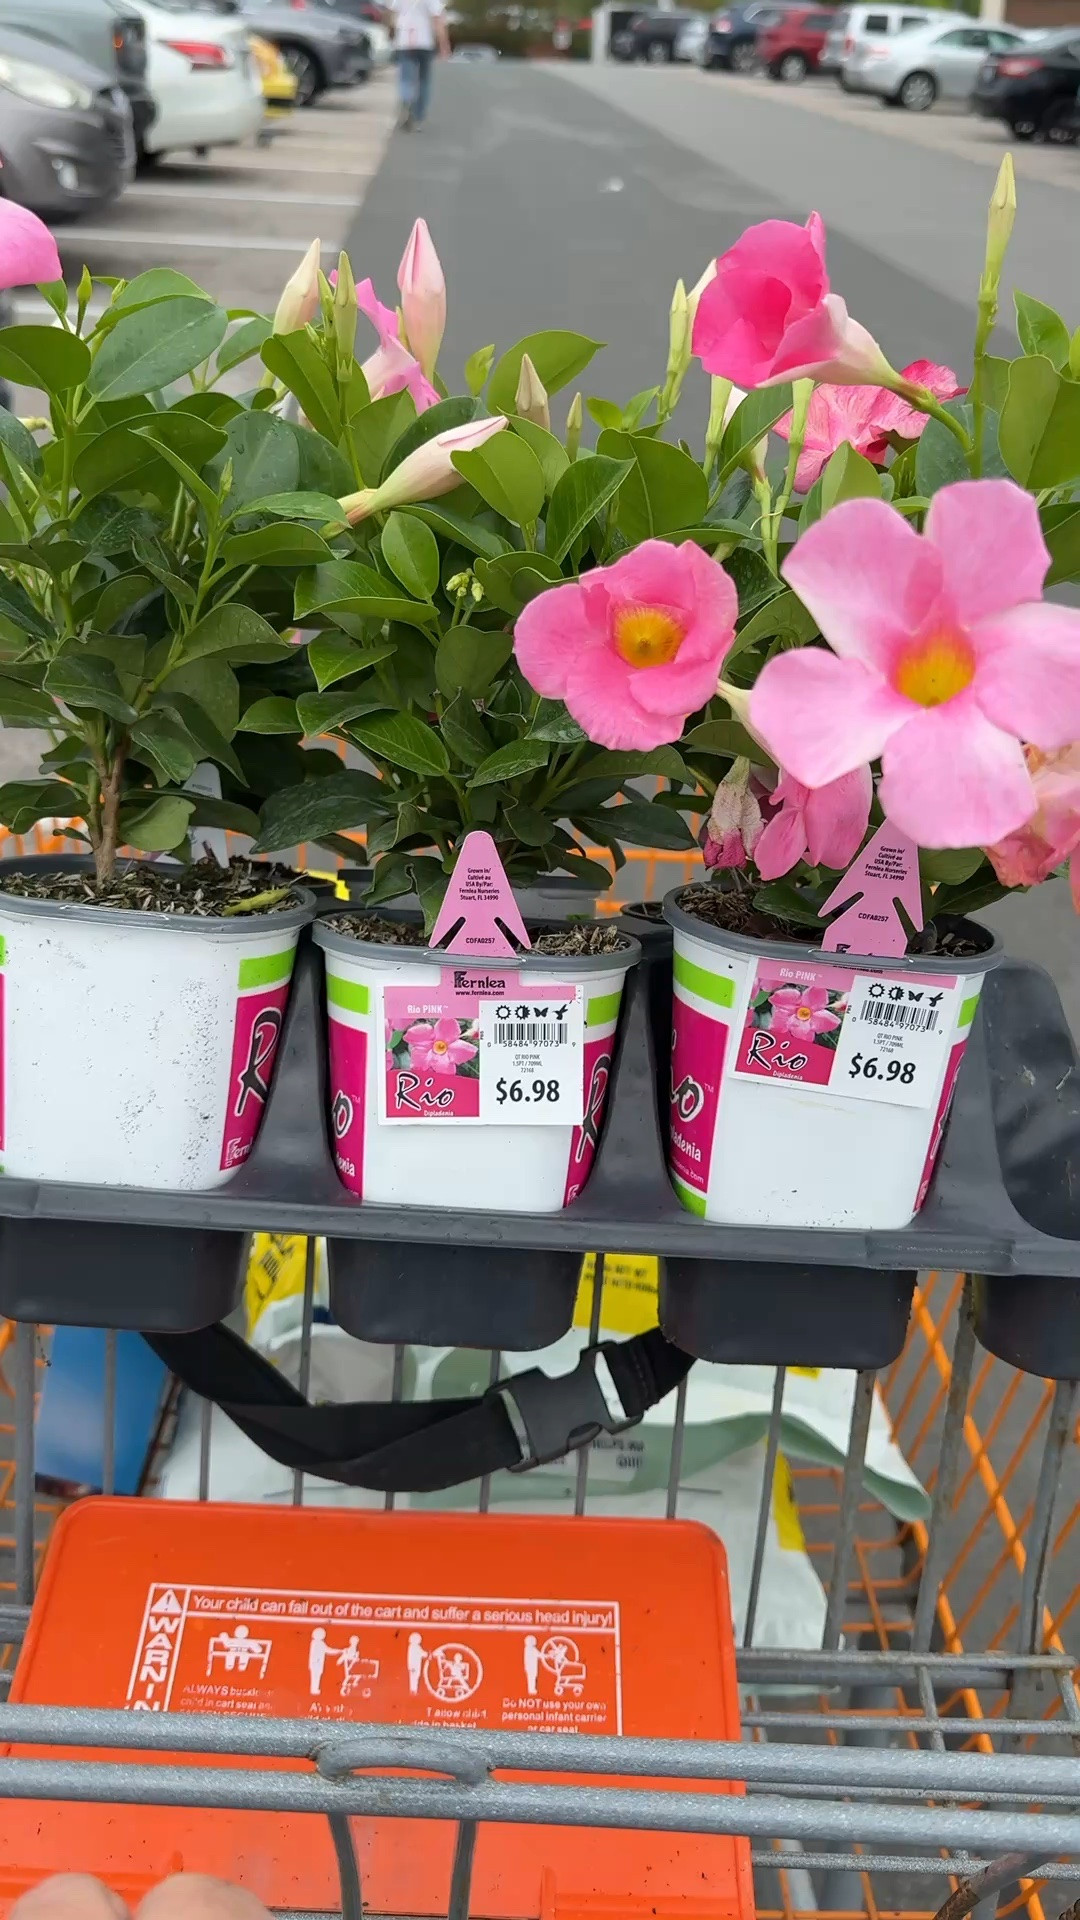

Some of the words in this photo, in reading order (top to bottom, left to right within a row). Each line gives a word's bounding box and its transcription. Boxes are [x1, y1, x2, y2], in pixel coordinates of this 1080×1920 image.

[864, 870, 881, 878] Stuart,
[865, 864, 884, 872] Fernlea
[884, 867, 907, 875] Nurseries
[779, 967, 794, 978] Rio
[453, 970, 506, 989] Fernlea
[407, 1005, 420, 1014] Rio
[867, 1017, 895, 1028] 58484
[898, 1022, 926, 1033] 97073
[502, 1040, 529, 1048] 58484
[532, 1040, 560, 1048] 97073
[746, 1030, 809, 1071] Rio
[848, 1053, 916, 1084] $6.98
[772, 1070, 803, 1081] Dipladenia
[395, 1071, 455, 1111] Rio
[496, 1077, 560, 1104] $6.98
[193, 1594, 224, 1610] Your
[226, 1597, 259, 1611] child
[260, 1601, 286, 1613] can
[288, 1599, 309, 1614] fall
[310, 1603, 333, 1615] out
[334, 1602, 350, 1616] of
[351, 1603, 372, 1617] the
[374, 1605, 401, 1618] cart
[403, 1606, 430, 1619] and
[431, 1607, 471, 1621] suffer
[471, 1609, 482, 1621] a
[483, 1608, 533, 1623] serious
[535, 1609, 570, 1624] head
[572, 1610, 613, 1627] injury!
[182, 1684, 229, 1697] ALWAYS
[215, 1699, 235, 1708] cart
[502, 1697, 517, 1708] Do
[518, 1698, 543, 1709] NOT
[543, 1700, 561, 1709] use
[563, 1701, 584, 1712] your
[501, 1711, 544, 1722] personal
[545, 1711, 574, 1722] infant
[574, 1713, 607, 1722] carrier
[538, 1725, 556, 1733] car
[557, 1725, 579, 1733] seat
